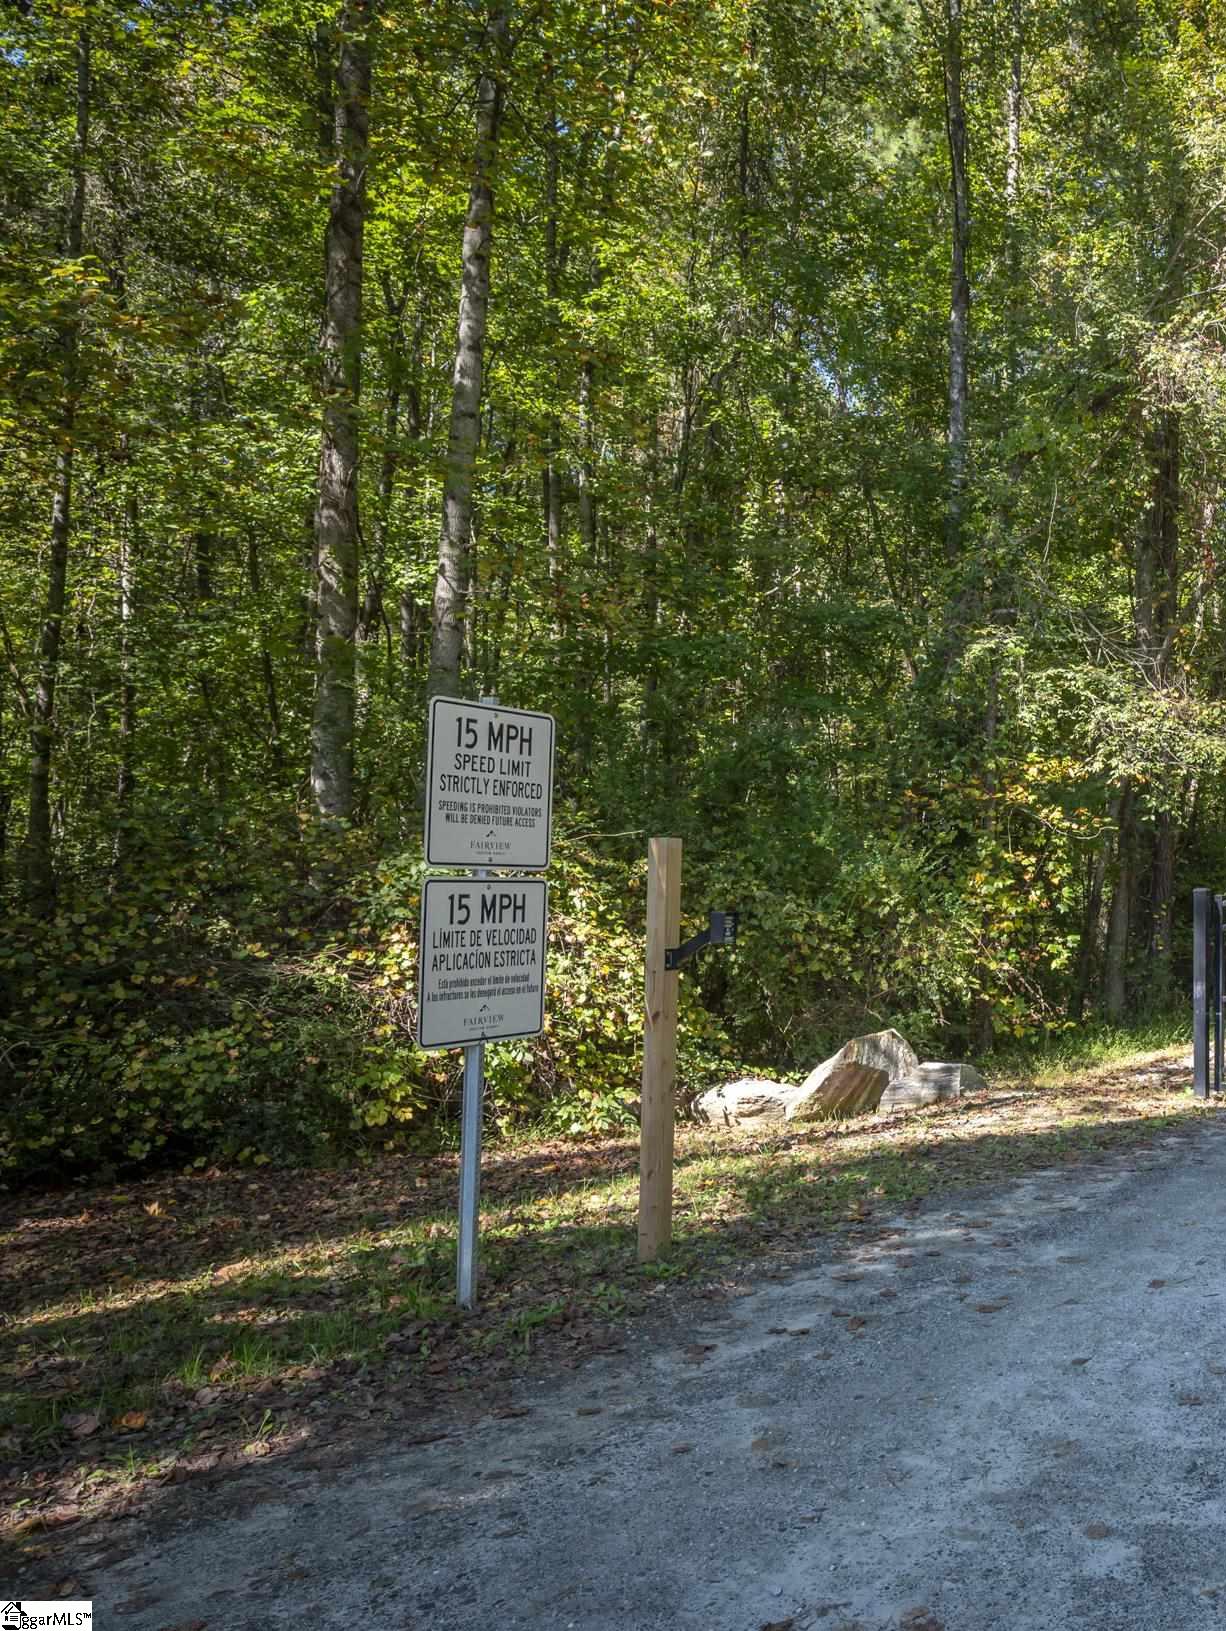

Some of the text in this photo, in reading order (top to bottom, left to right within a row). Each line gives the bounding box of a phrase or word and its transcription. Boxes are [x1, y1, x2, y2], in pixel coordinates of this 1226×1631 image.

[455, 716, 533, 757] 15 MPH
[454, 753, 532, 778] SPEED LIMIT
[440, 774, 543, 800] STRICTLY ENFORCED
[438, 800, 542, 818] SPEEDING IS PROHIBITED VIOLATORS
[445, 813, 536, 828] WILL BE DENIED FUTURE ACCESS
[470, 840, 512, 850] FAIRVIEW
[448, 893, 526, 925] 15 MPH
[432, 927, 537, 949] LÍMITE DE VELOCIDAD
[494, 949, 536, 968] ESTRICTA
[463, 1015, 505, 1027] FAIRVIEW
